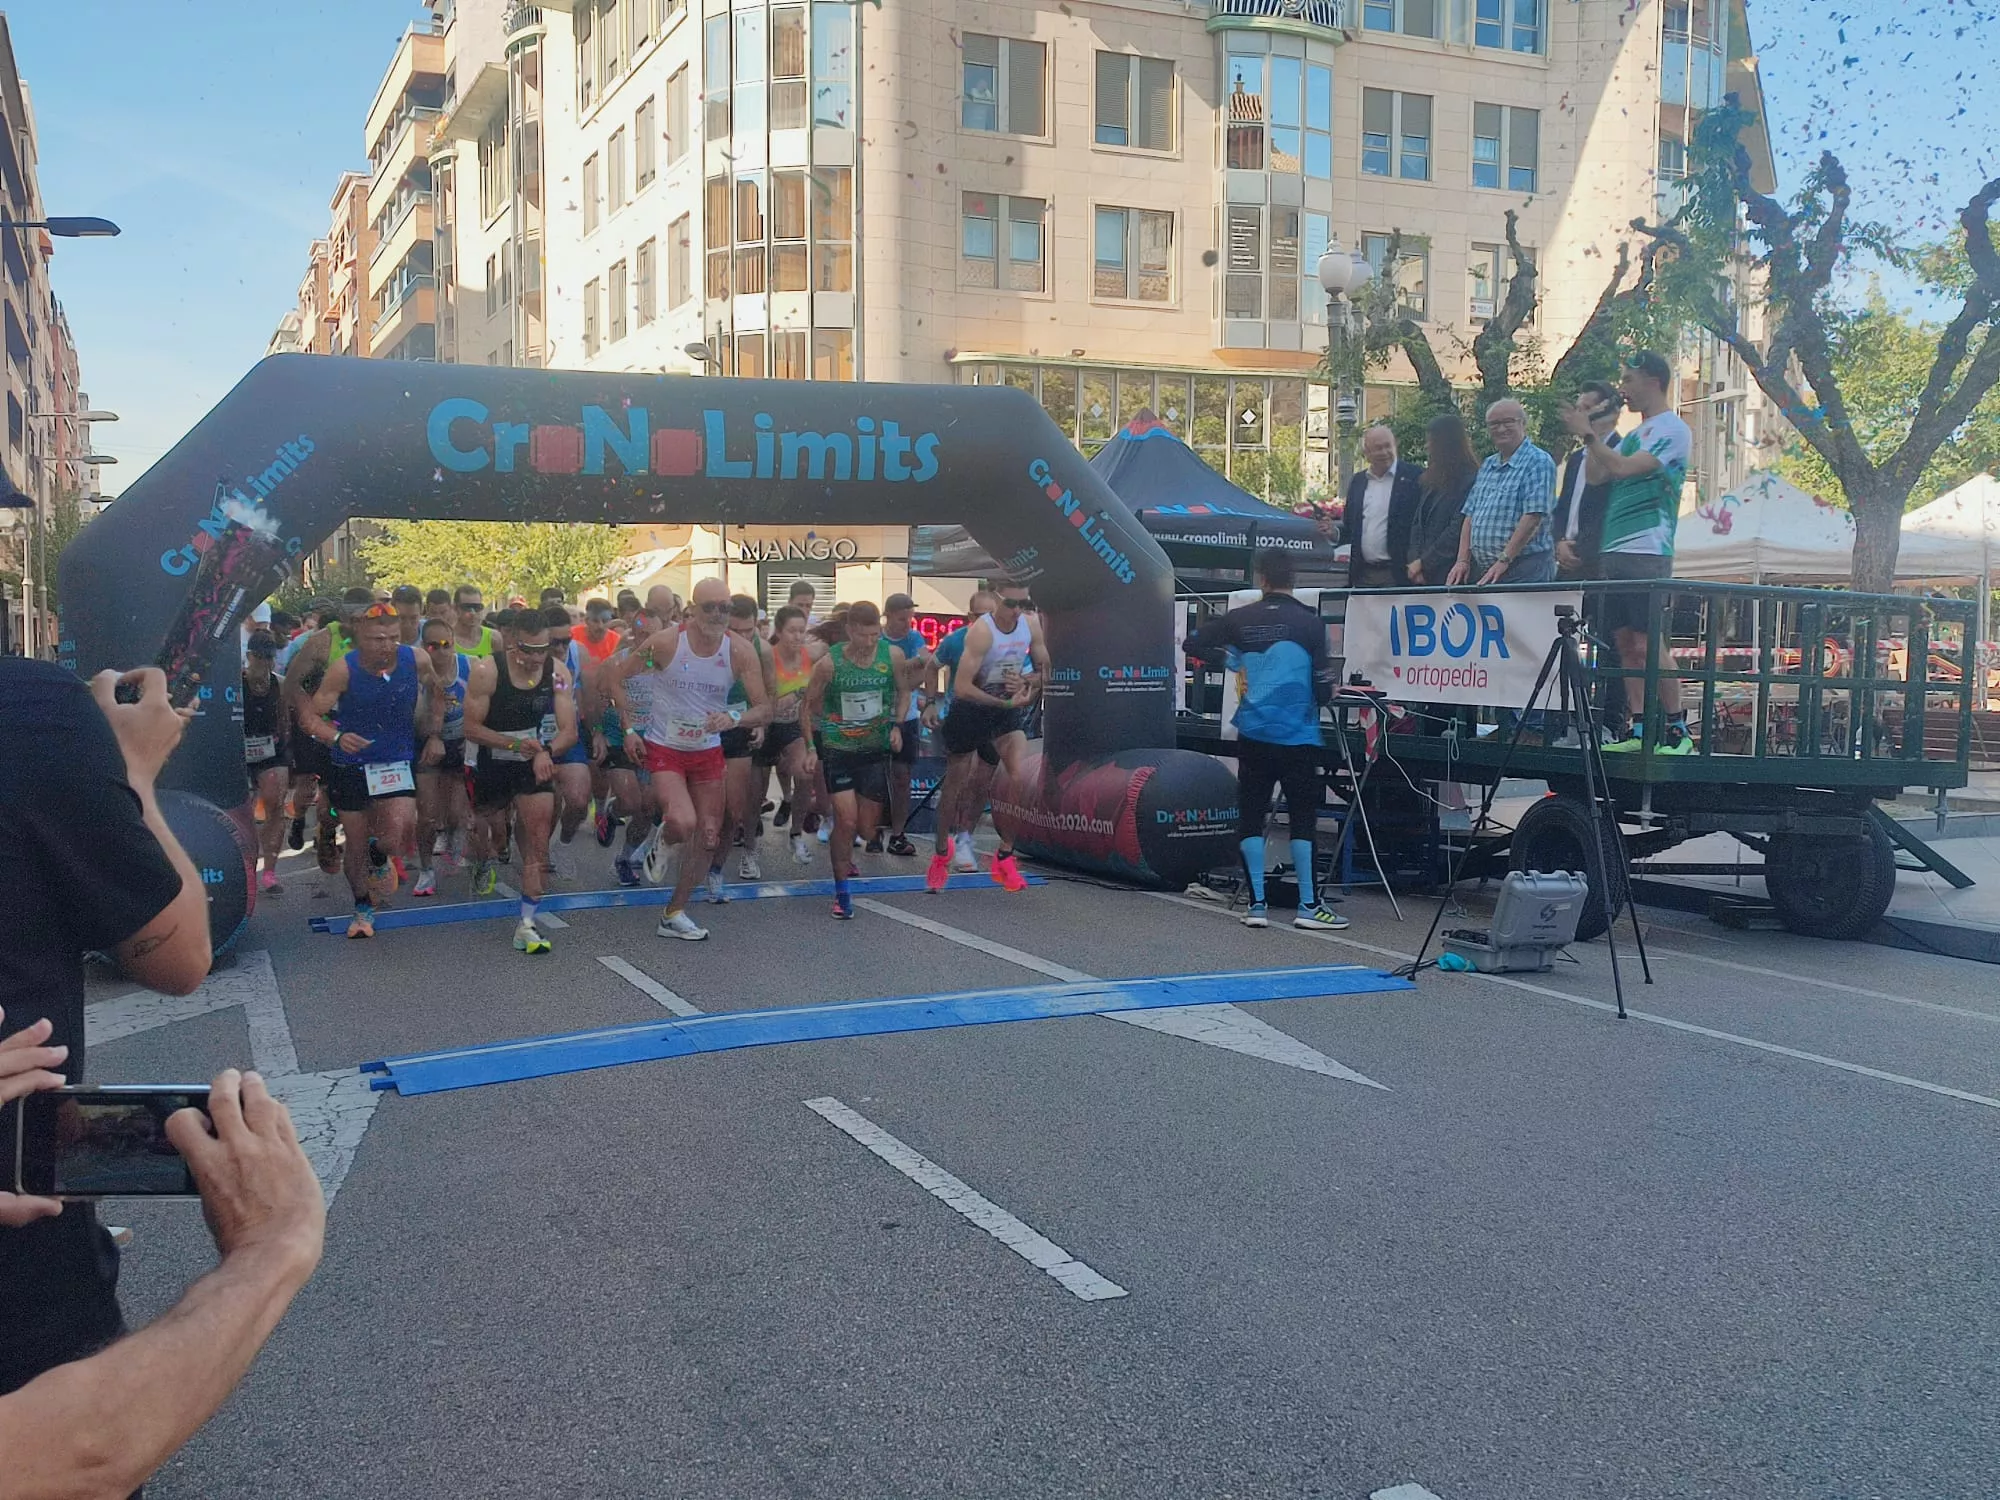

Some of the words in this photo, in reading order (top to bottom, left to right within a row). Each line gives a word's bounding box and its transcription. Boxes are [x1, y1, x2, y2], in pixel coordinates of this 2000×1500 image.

[739, 537, 857, 561] MANGO
[1390, 602, 1511, 659] IBOR
[1406, 661, 1488, 692] ortopedia
[677, 727, 703, 738] 249
[380, 773, 402, 785] 221
